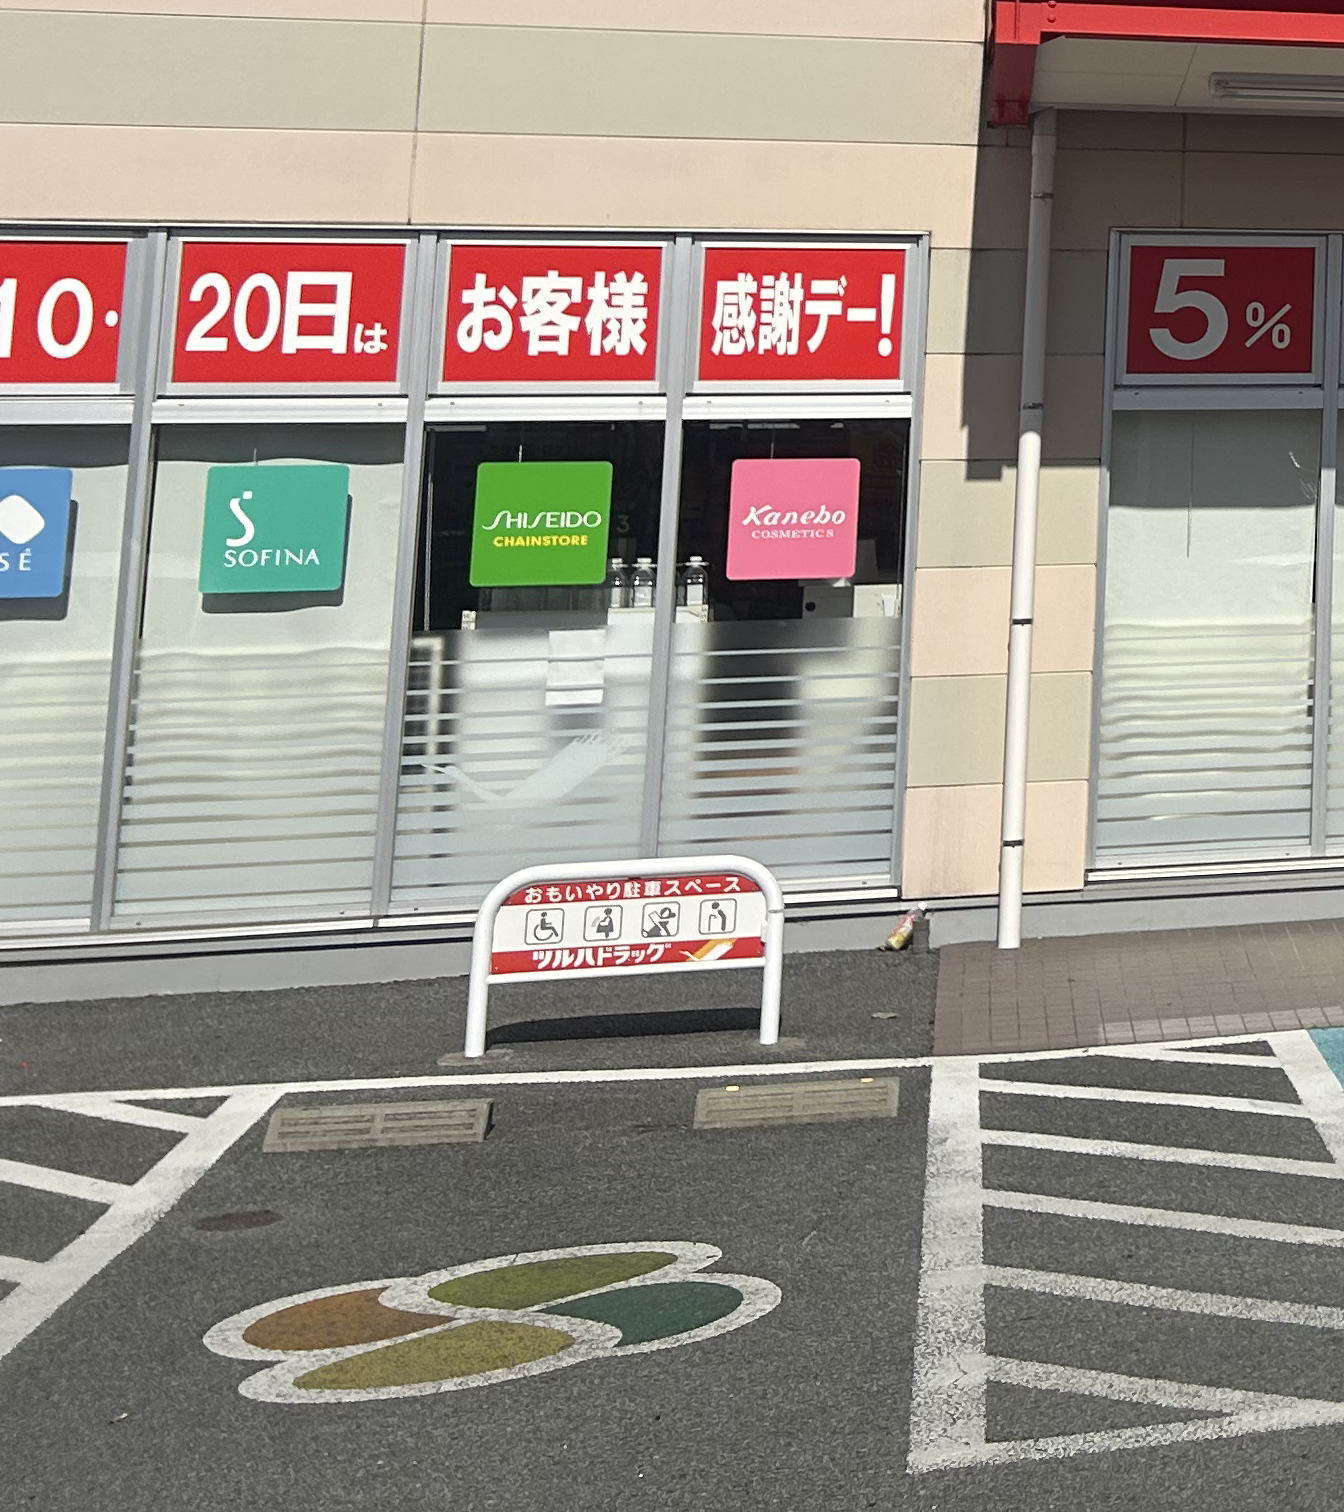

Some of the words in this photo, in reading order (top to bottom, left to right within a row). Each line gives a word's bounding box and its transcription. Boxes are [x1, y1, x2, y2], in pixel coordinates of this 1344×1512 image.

[185, 271, 388, 355] 20日は
[456, 270, 648, 356] お客様
[1149, 259, 1291, 360] 5%
[482, 509, 602, 529] SHISEIDO
[741, 504, 846, 529] Kanebo
[494, 534, 589, 548] CHAINSTORE
[751, 528, 834, 540] COSMETICS
[224, 548, 320, 568] SOFINA
[524, 877, 742, 904] おもいやり駐車スペース
[532, 943, 672, 969] ツルハドラッグ
